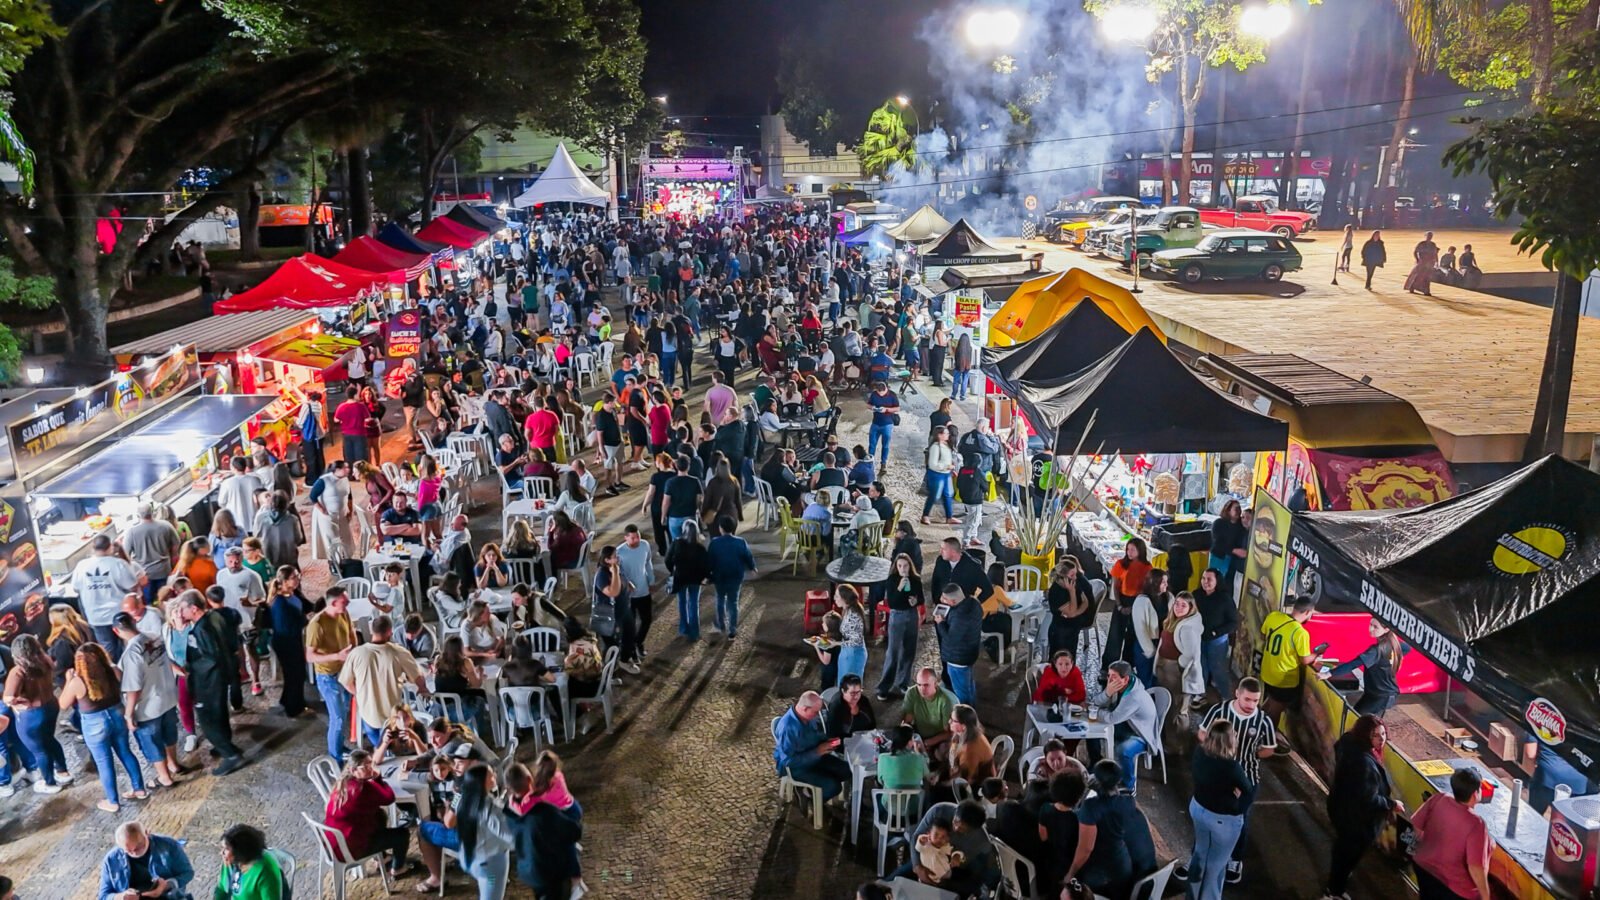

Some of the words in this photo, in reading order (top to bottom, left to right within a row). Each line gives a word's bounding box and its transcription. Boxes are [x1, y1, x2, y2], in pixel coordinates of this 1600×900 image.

[960, 303, 977, 311] Pastel
[23, 417, 50, 442] SABOR
[49, 411, 65, 430] QUE
[27, 440, 43, 457] TE
[1292, 537, 1320, 568] CAIXA
[1529, 705, 1561, 736] BRAHMA
